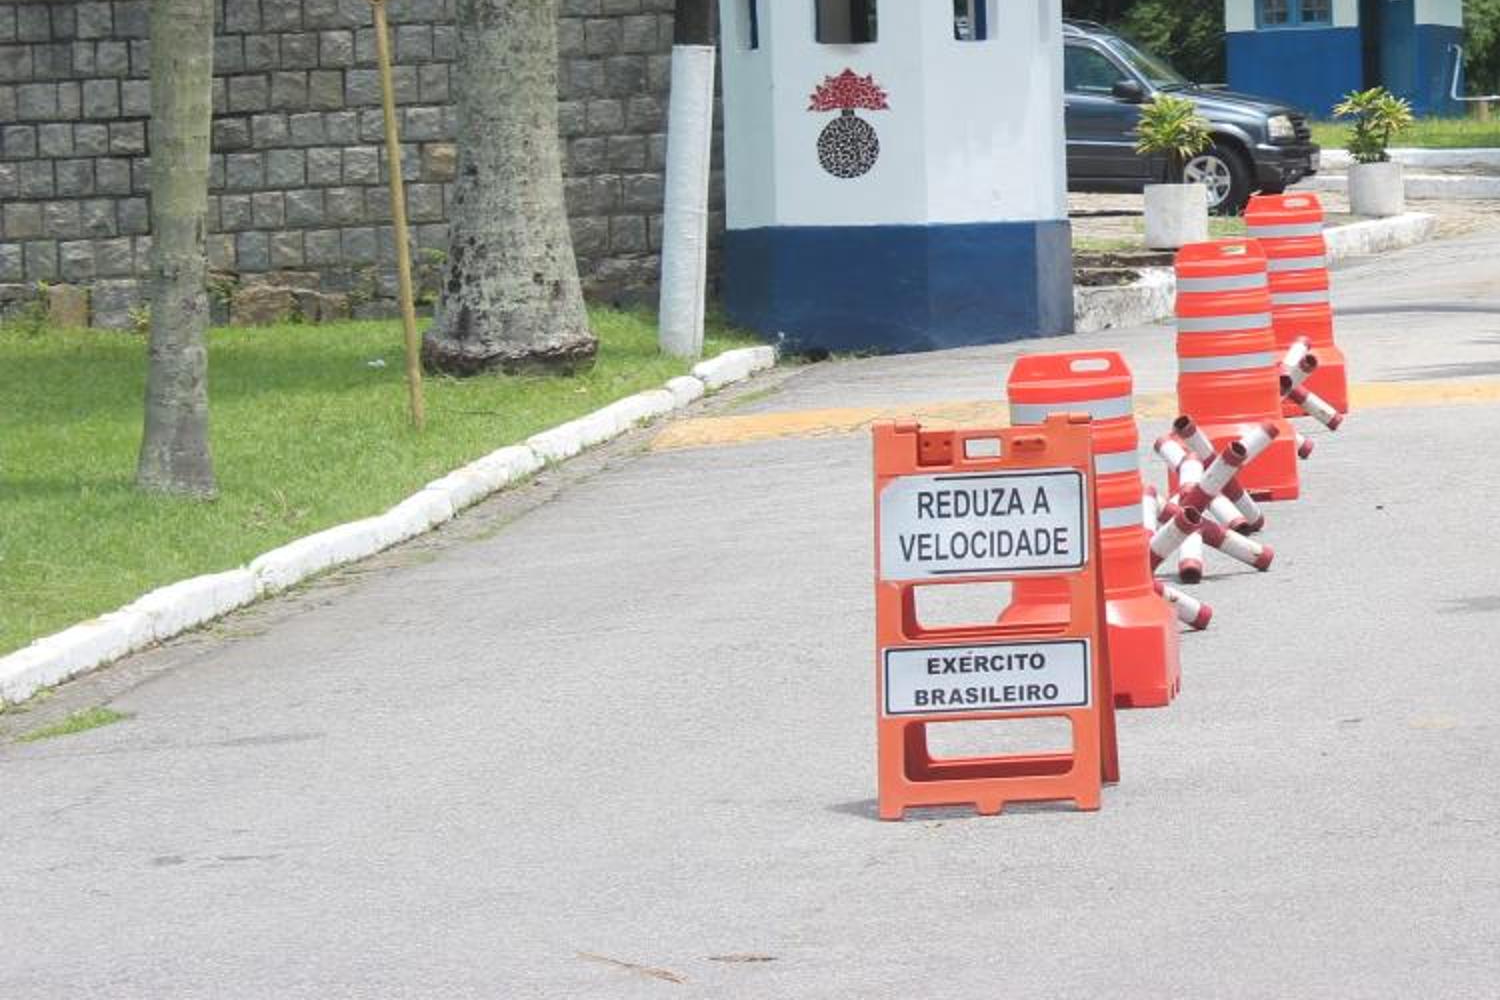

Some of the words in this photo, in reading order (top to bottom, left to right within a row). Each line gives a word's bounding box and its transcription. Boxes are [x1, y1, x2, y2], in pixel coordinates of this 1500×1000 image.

[917, 487, 1024, 519] REDUZA
[1032, 485, 1051, 514] A
[899, 527, 1069, 562] VELOCIDADE
[914, 683, 1059, 706] BRASILEIRO
